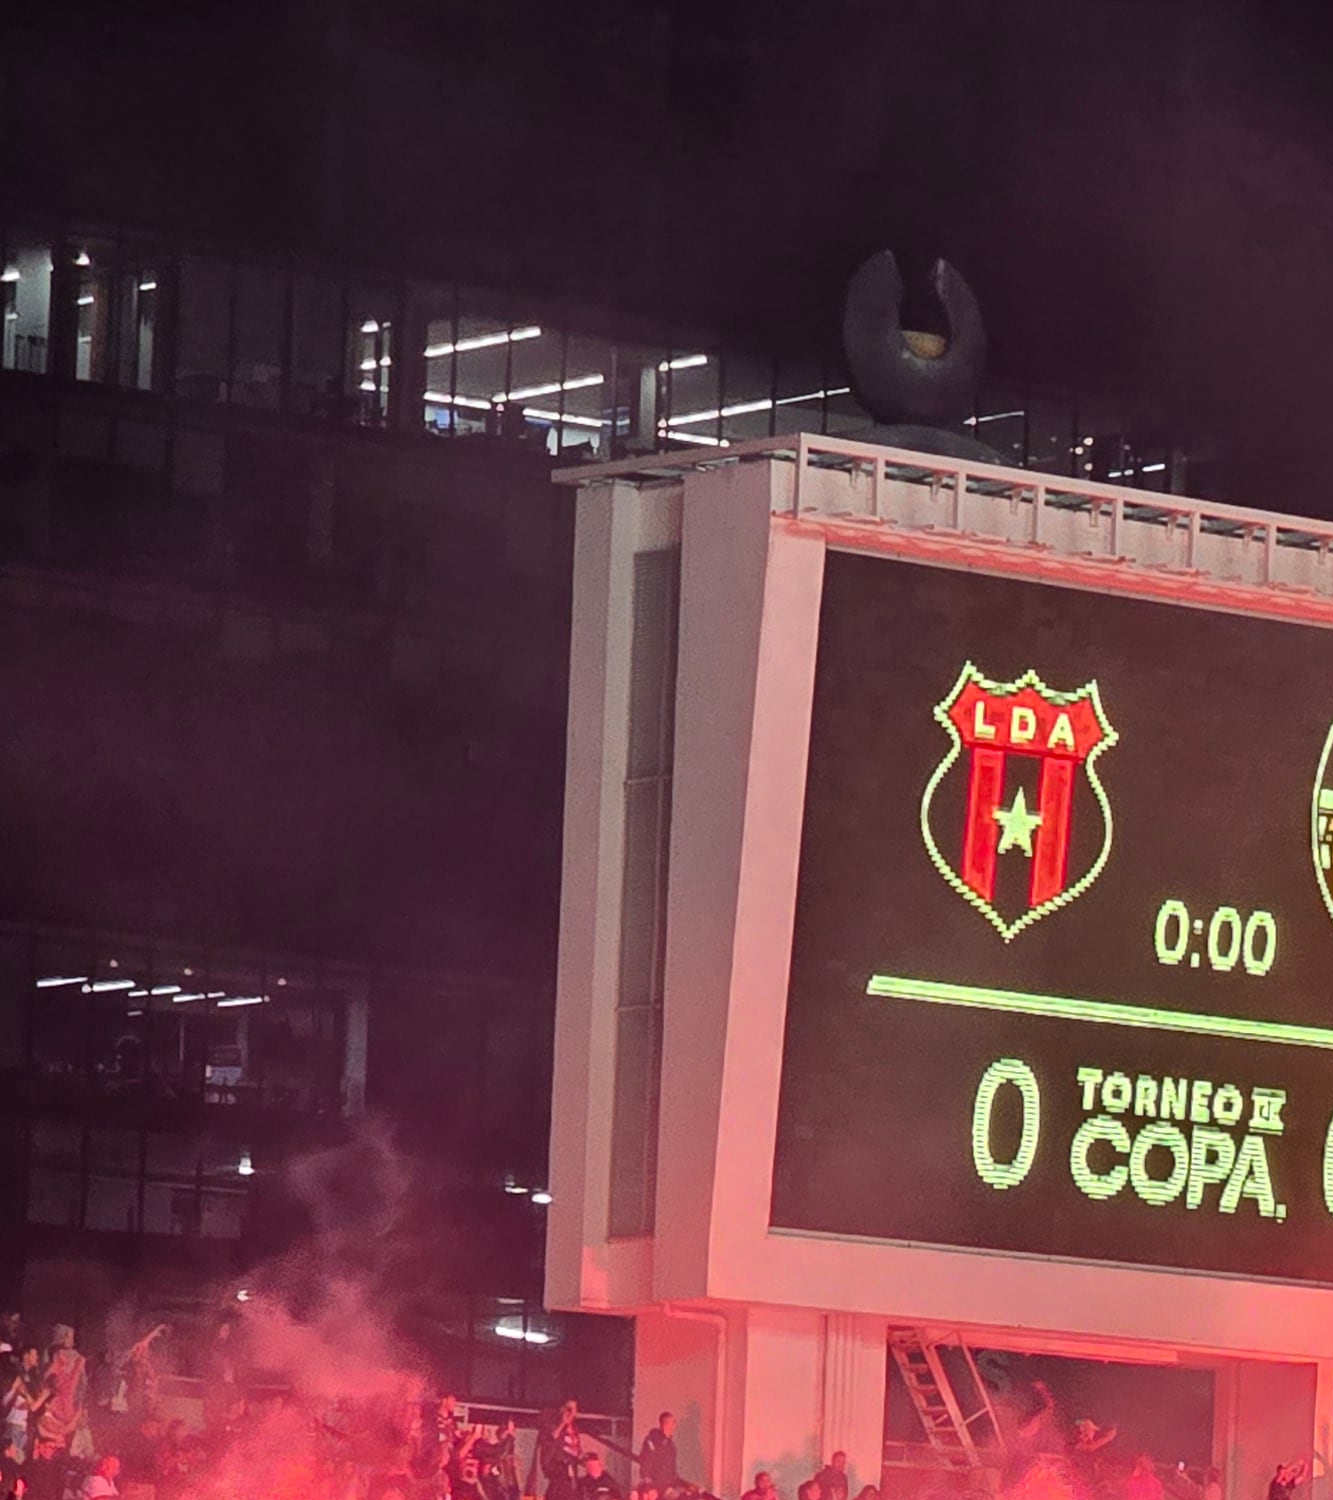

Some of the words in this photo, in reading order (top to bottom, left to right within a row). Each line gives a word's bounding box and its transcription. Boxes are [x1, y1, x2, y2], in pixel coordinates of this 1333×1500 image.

[973, 701, 1076, 750] LDA
[1153, 900, 1278, 976] 0:00
[972, 1058, 1040, 1190] 0
[1076, 1066, 1244, 1126] TORNEO
